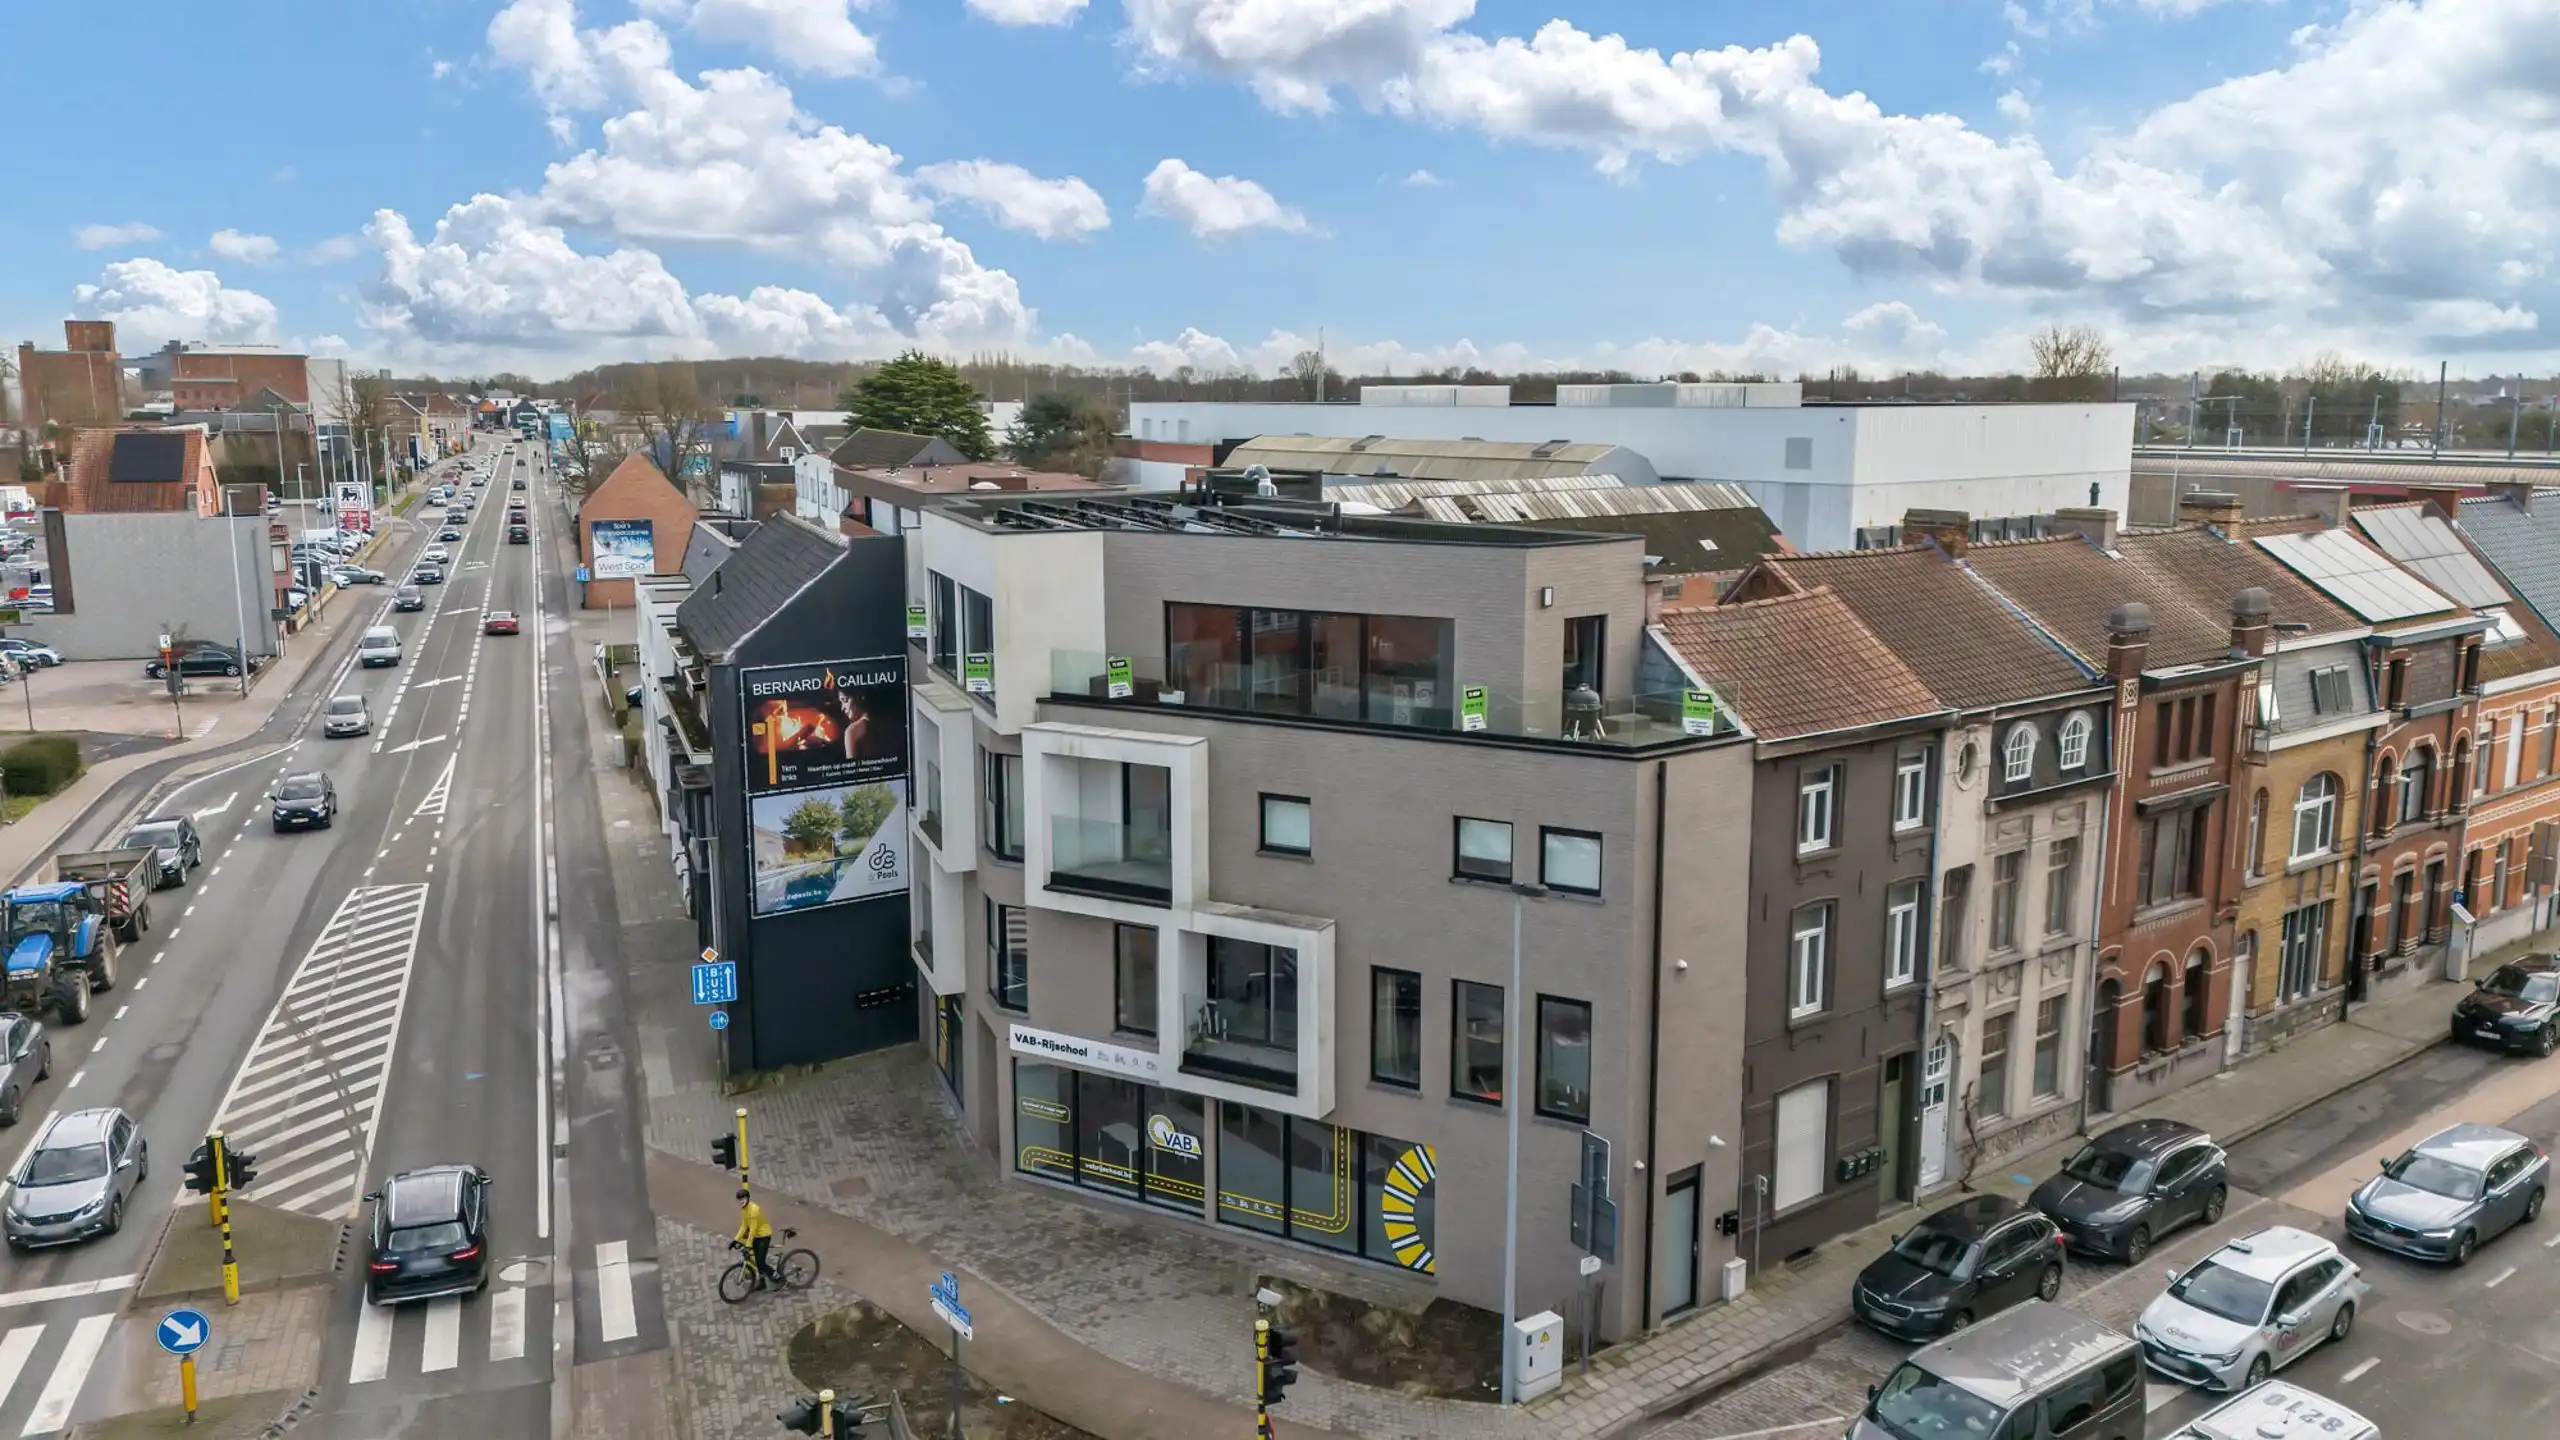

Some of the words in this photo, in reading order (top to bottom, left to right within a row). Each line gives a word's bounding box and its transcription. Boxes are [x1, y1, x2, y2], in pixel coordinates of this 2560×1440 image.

[598, 563, 623, 571] West
[625, 561, 646, 572] Spa
[752, 678, 822, 696] BERNARD
[837, 671, 897, 688] CAILLIAU
[710, 968, 719, 998] BUS
[1014, 1032, 1088, 1057] VAB-Rijschool
[1162, 1131, 1193, 1150] VAB
[2263, 1393, 2345, 1432] 8210
